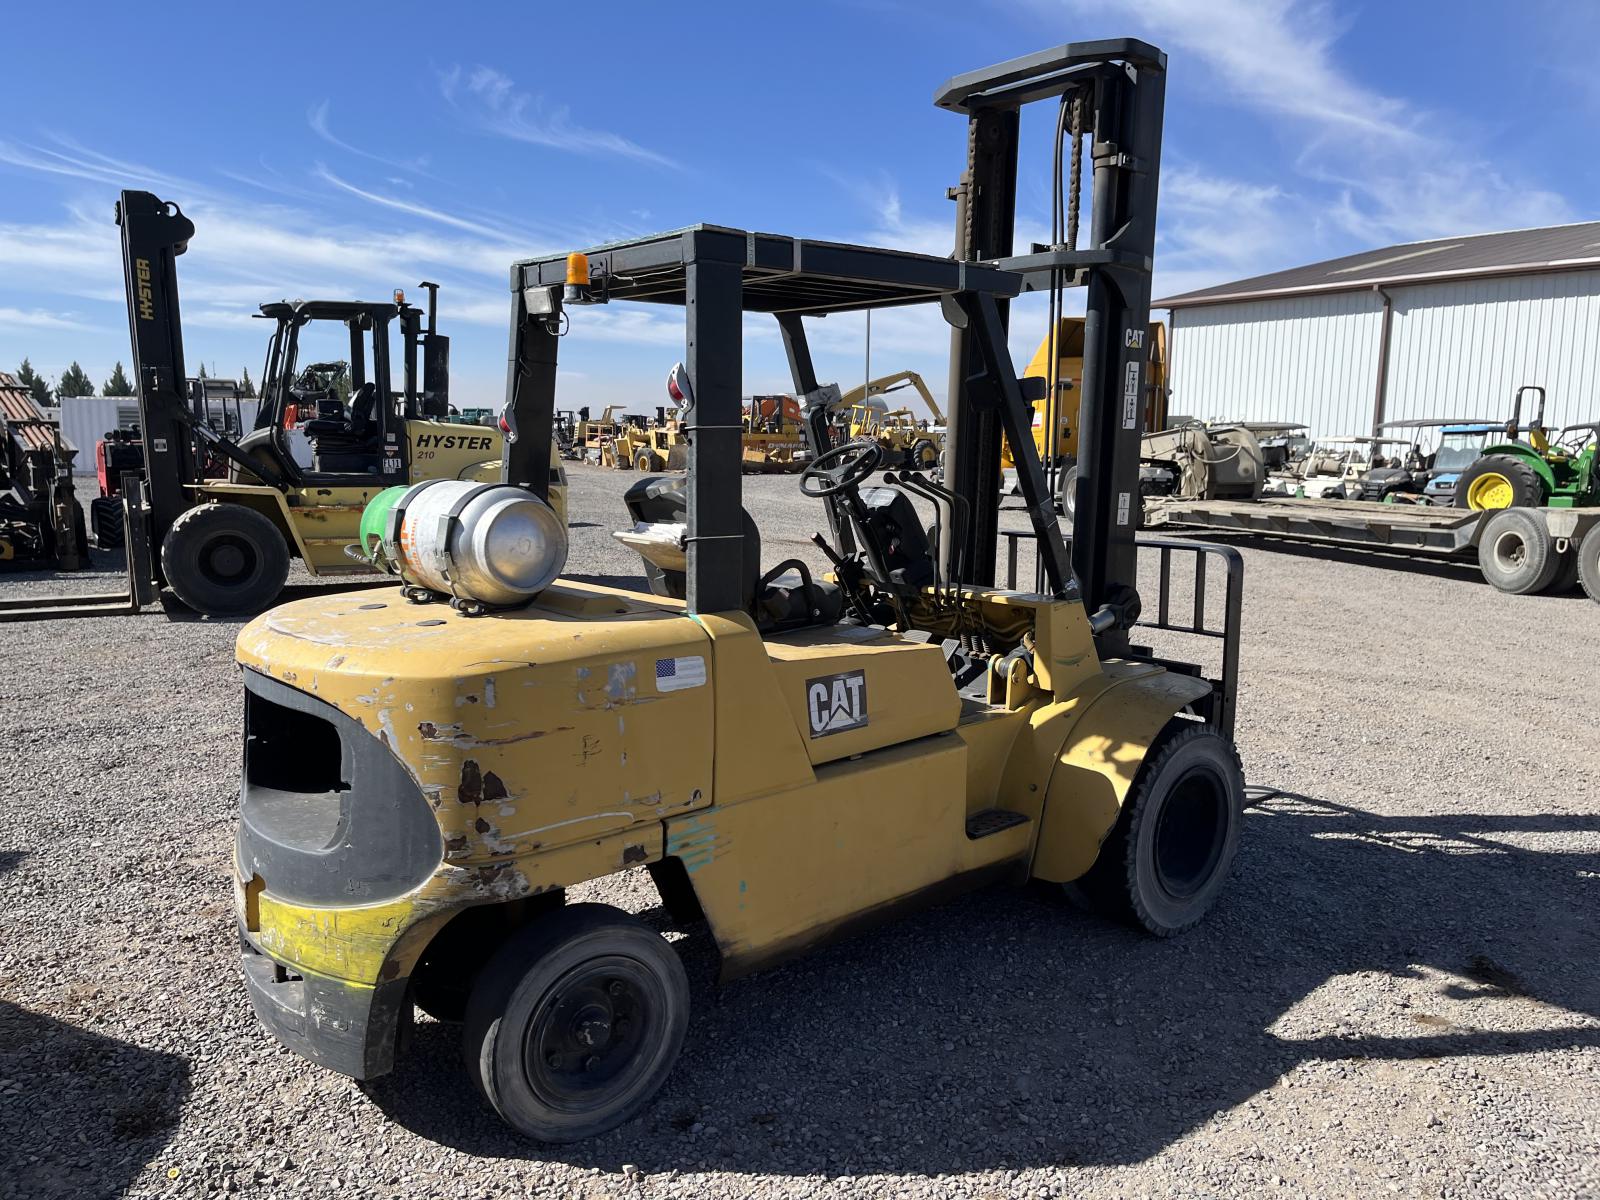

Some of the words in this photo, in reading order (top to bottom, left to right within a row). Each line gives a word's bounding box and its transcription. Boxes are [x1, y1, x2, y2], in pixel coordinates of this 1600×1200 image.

[136, 258, 154, 320] HYSTER
[1125, 328, 1145, 349] CAT
[416, 434, 493, 450] HYSTER
[417, 451, 435, 459] 210
[809, 675, 864, 732] CAT
